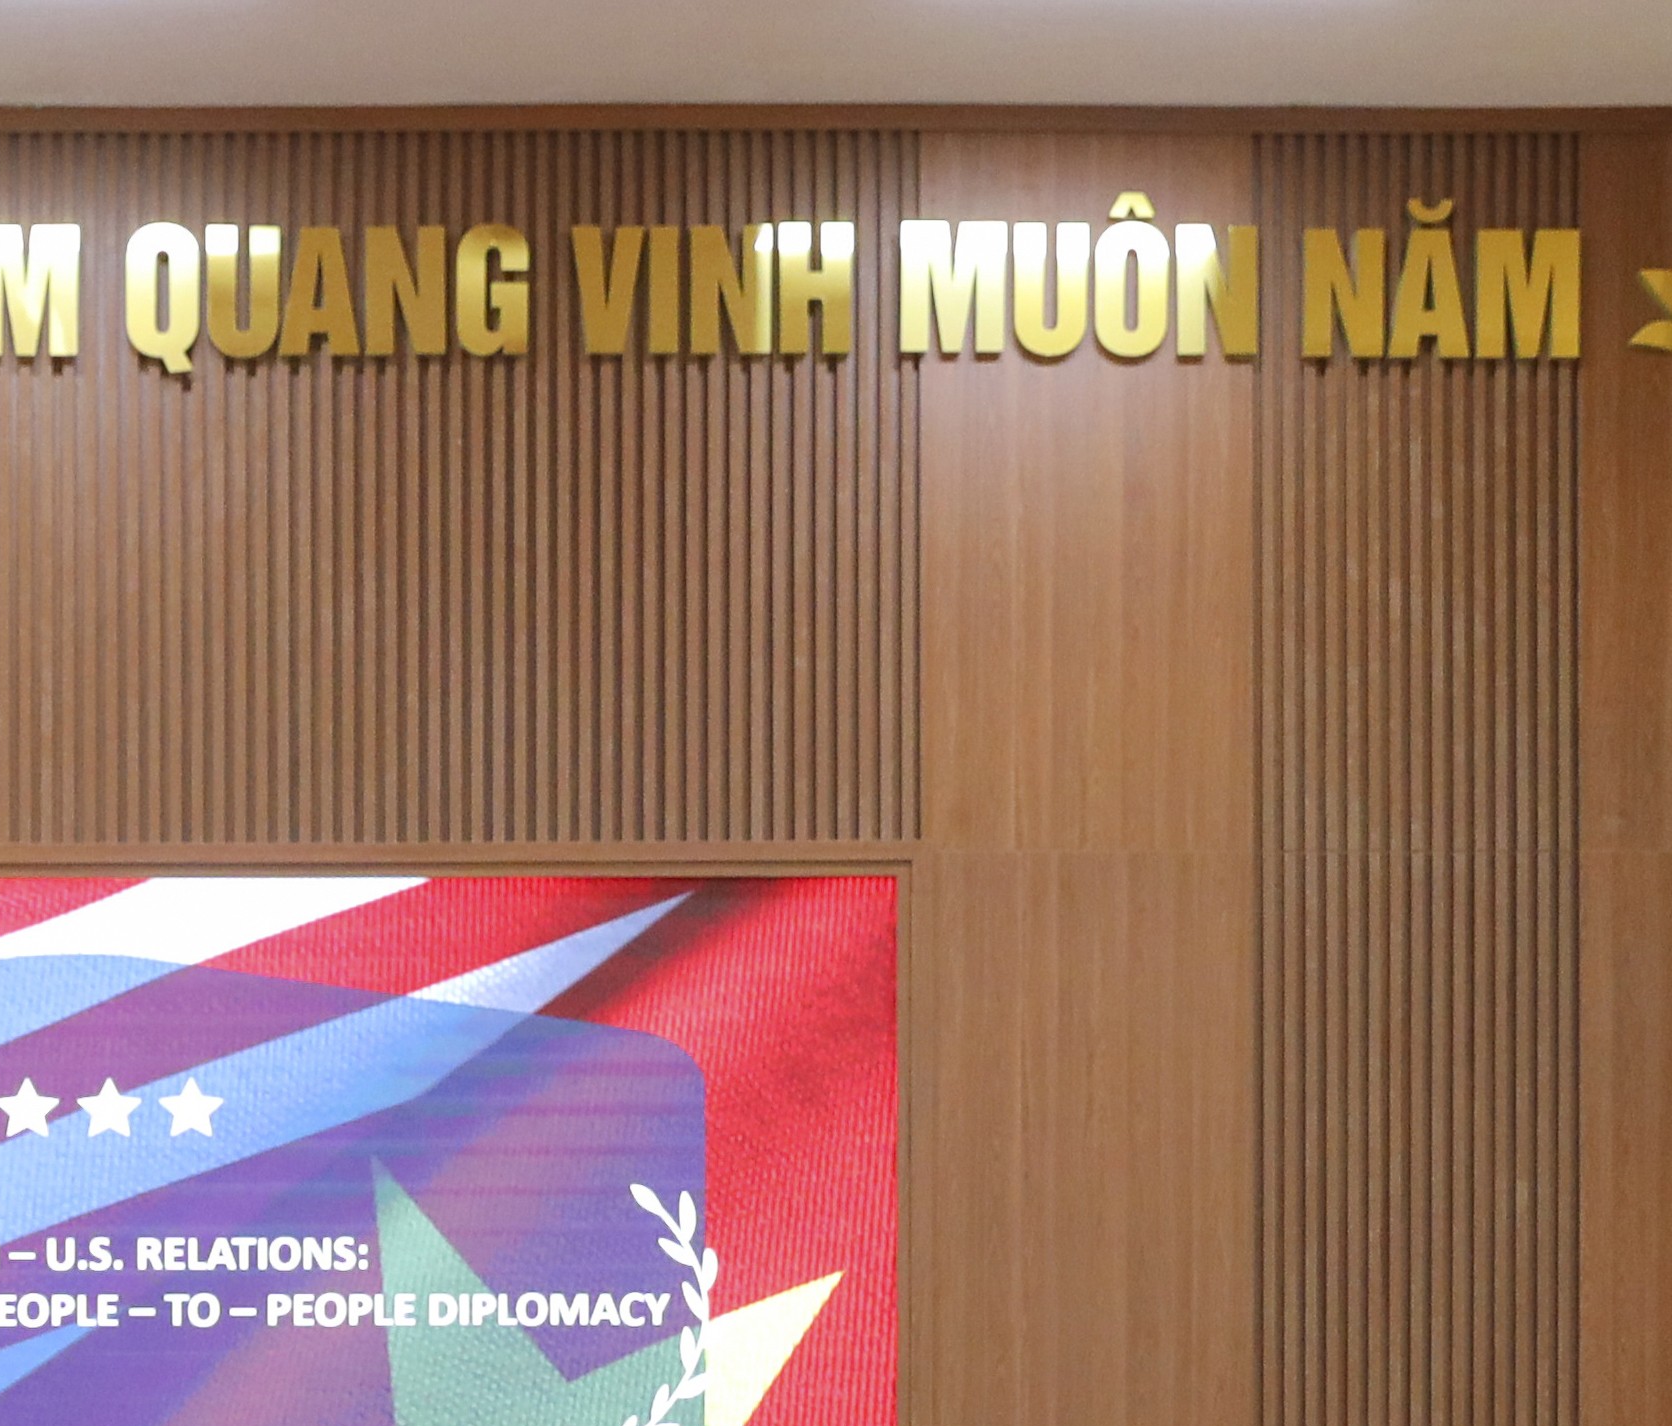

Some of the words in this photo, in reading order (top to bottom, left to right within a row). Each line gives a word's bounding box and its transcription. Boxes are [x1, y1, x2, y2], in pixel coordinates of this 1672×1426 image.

[124, 221, 529, 373] QUANG
[570, 220, 854, 355] VINH
[899, 190, 1256, 359] MUÔN
[1303, 198, 1580, 359] NĂM
[45, 1237, 124, 1271] U.S.
[137, 1236, 369, 1271] RELATIONS:
[164, 1293, 220, 1327] TO
[267, 1293, 416, 1327] PEOPLE
[429, 1293, 670, 1327] DIPLOMACY
